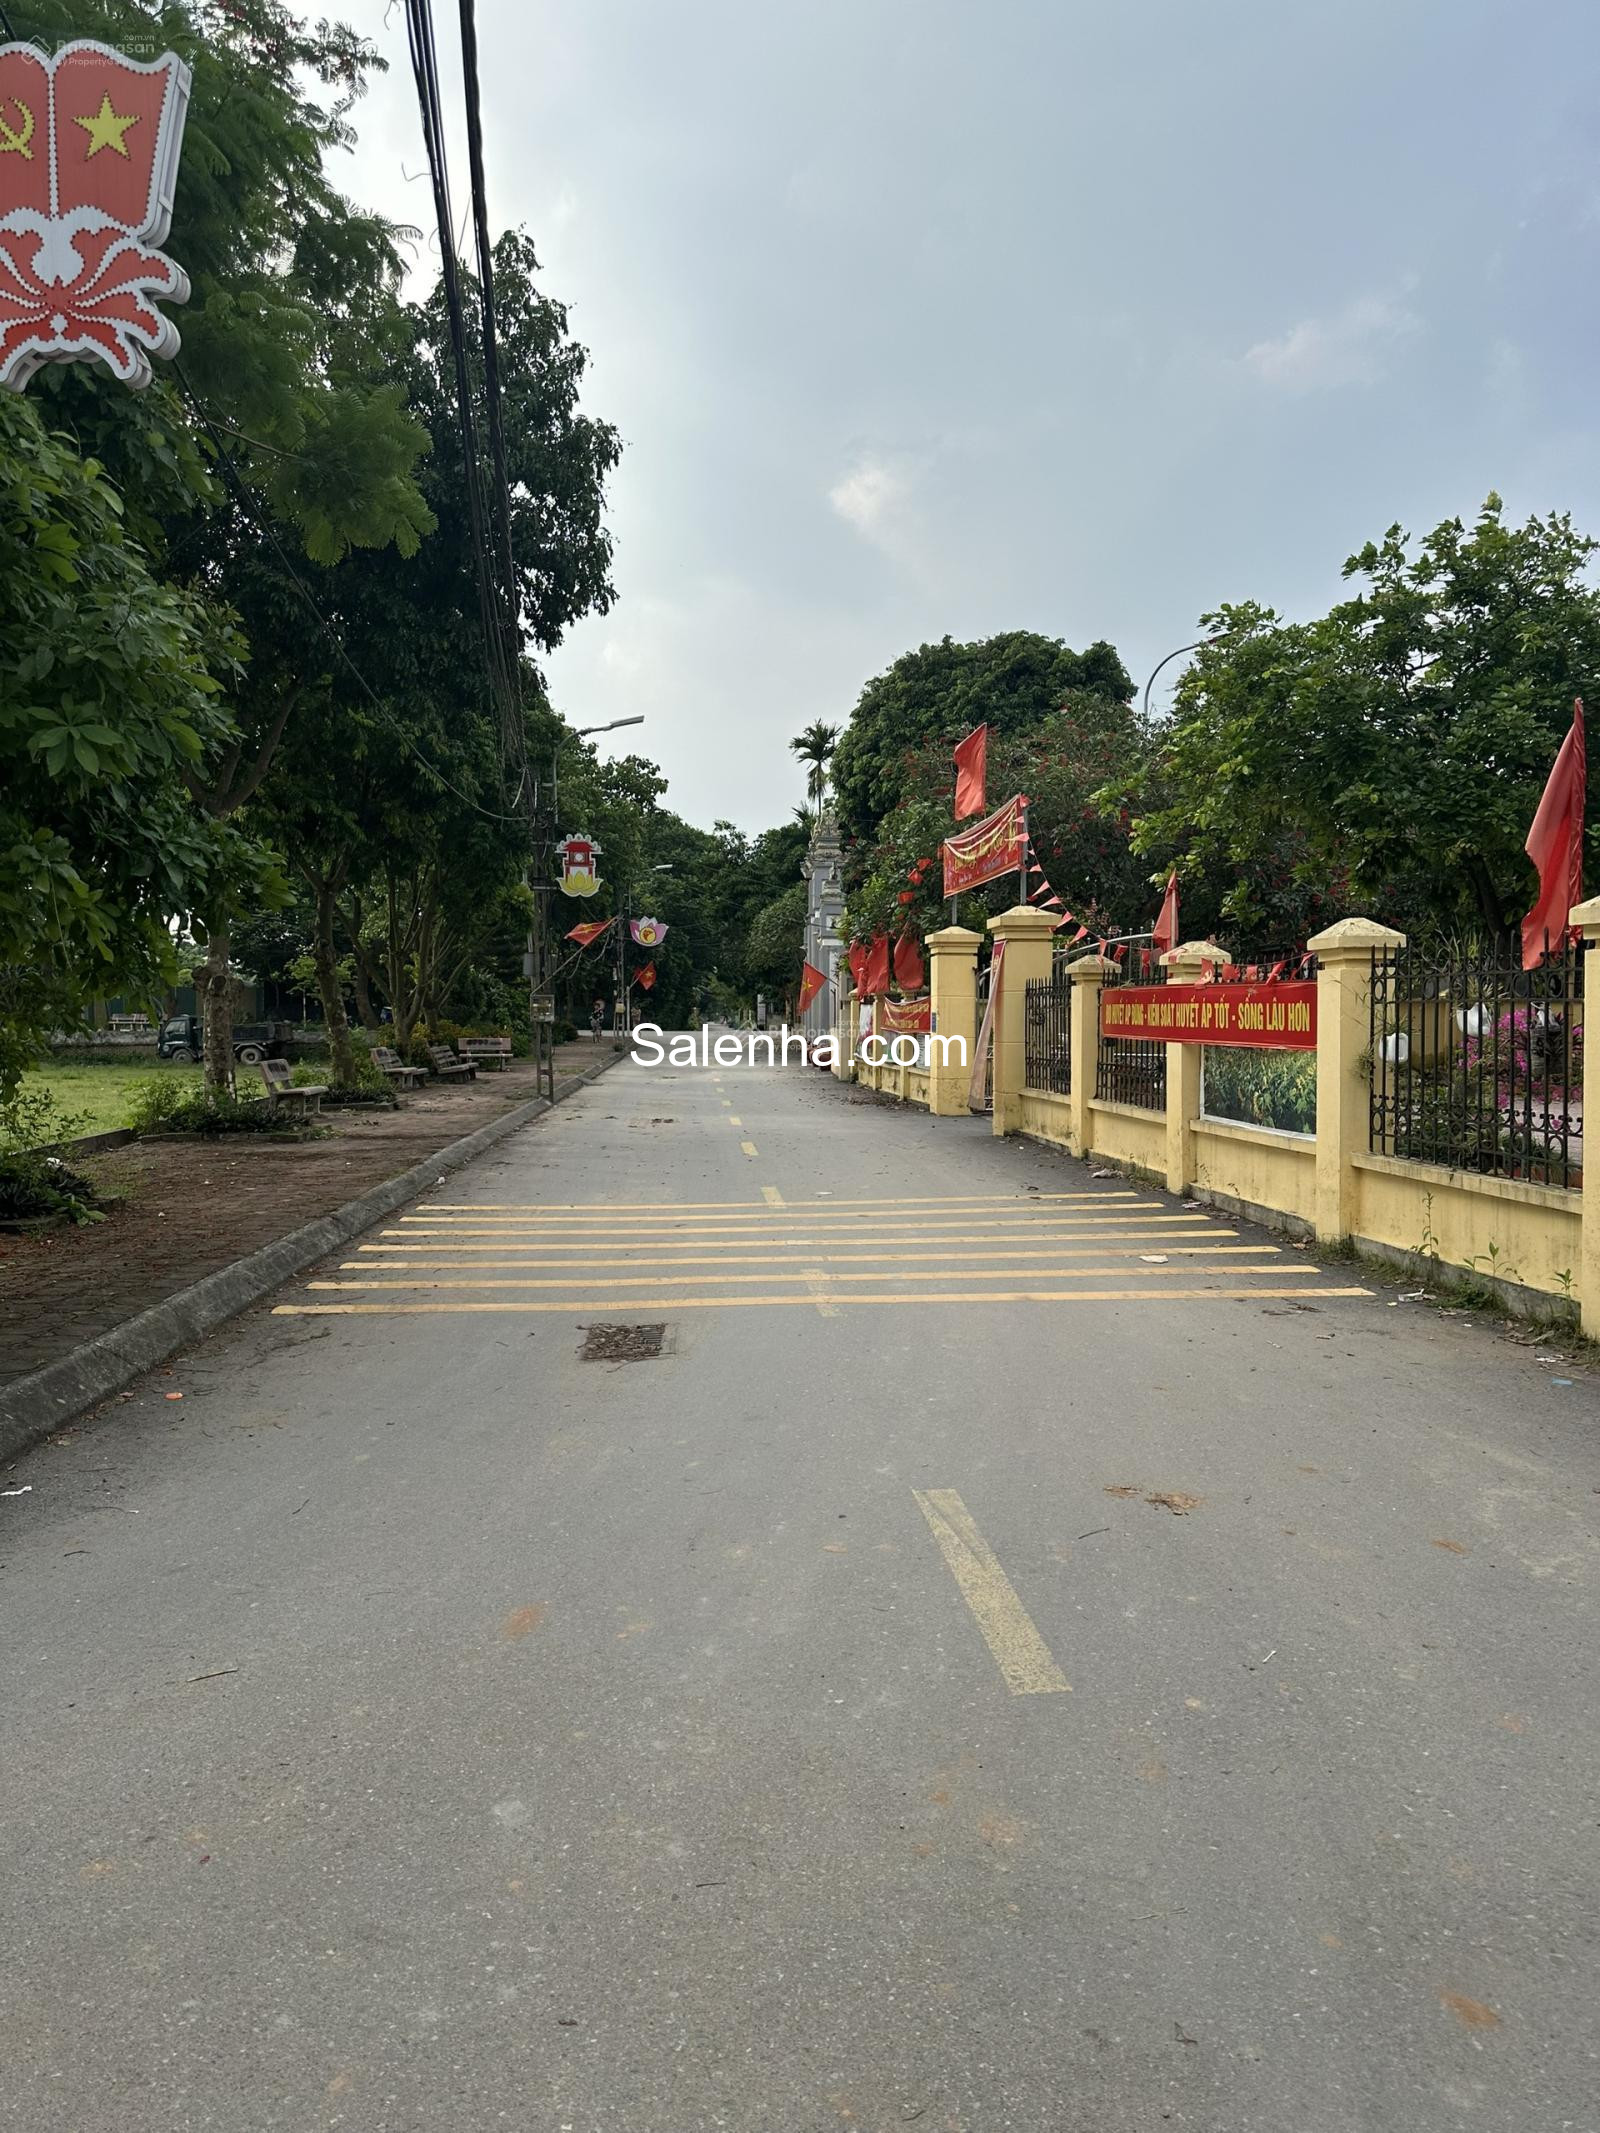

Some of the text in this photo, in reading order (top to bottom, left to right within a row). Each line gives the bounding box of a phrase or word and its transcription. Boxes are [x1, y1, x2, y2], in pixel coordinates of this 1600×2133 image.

[1175, 995, 1199, 1028] HUYẾT
[1201, 997, 1212, 1028] ÁP
[1214, 993, 1230, 1029] TỐT
[1238, 993, 1264, 1030] SỐNG
[1266, 997, 1285, 1031] LÂU
[1288, 1000, 1310, 1032] HƠN
